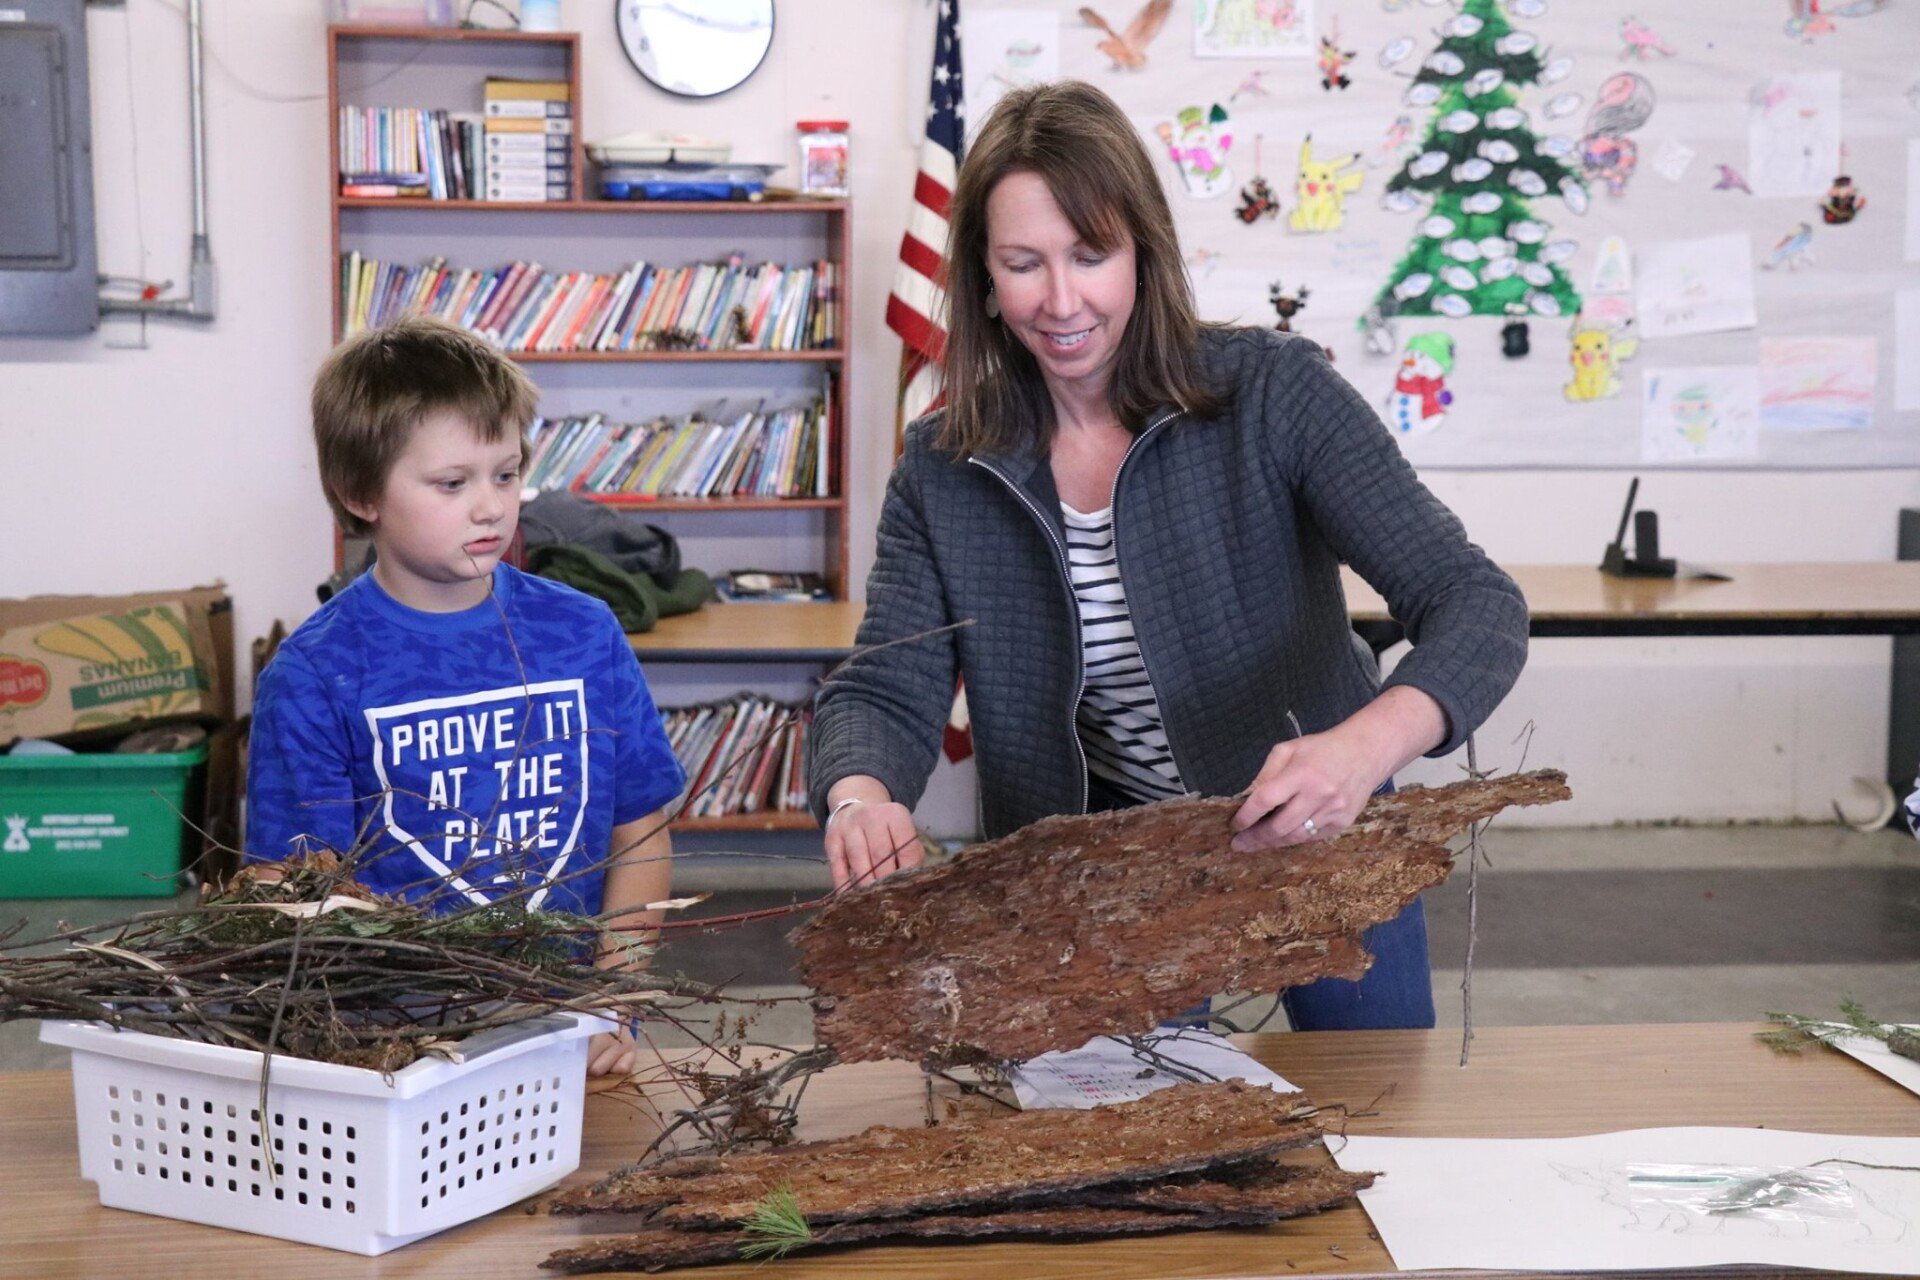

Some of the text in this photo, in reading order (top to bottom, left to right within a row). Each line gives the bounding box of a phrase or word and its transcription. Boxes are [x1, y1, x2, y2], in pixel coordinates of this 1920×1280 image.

[98, 670, 187, 698] Premium
[392, 701, 573, 766] PROVE IT
[427, 753, 563, 811] AT THE
[444, 806, 559, 861] PLATE
